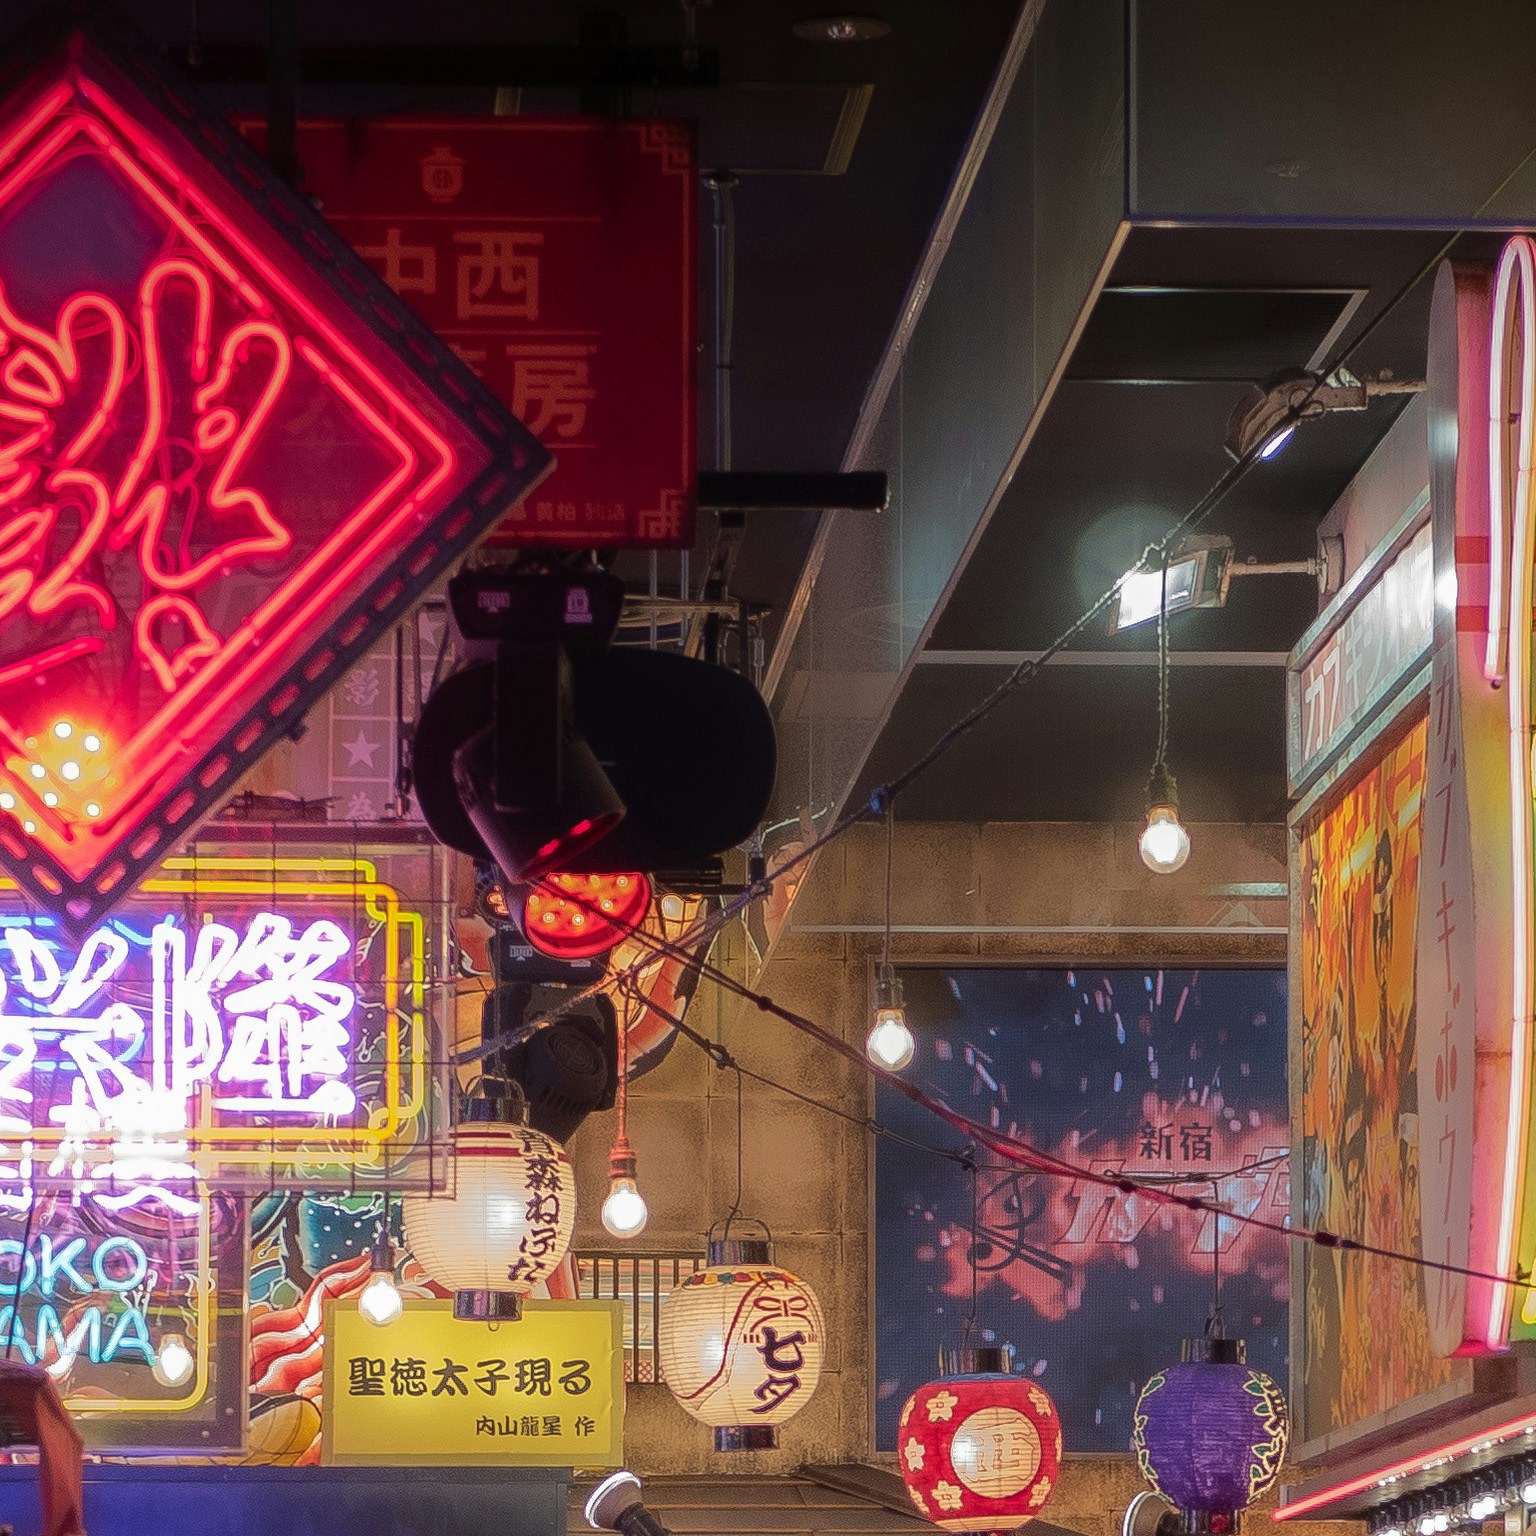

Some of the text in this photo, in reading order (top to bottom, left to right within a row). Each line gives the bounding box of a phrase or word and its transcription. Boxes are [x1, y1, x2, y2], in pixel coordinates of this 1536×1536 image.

[356, 228, 544, 321] 中西
[1139, 1121, 1213, 1161] 新宿
[1055, 1146, 1290, 1254] カブ
[348, 1357, 592, 1398] 聖徳太子現る
[475, 1415, 596, 1437] 内山龍星 作
